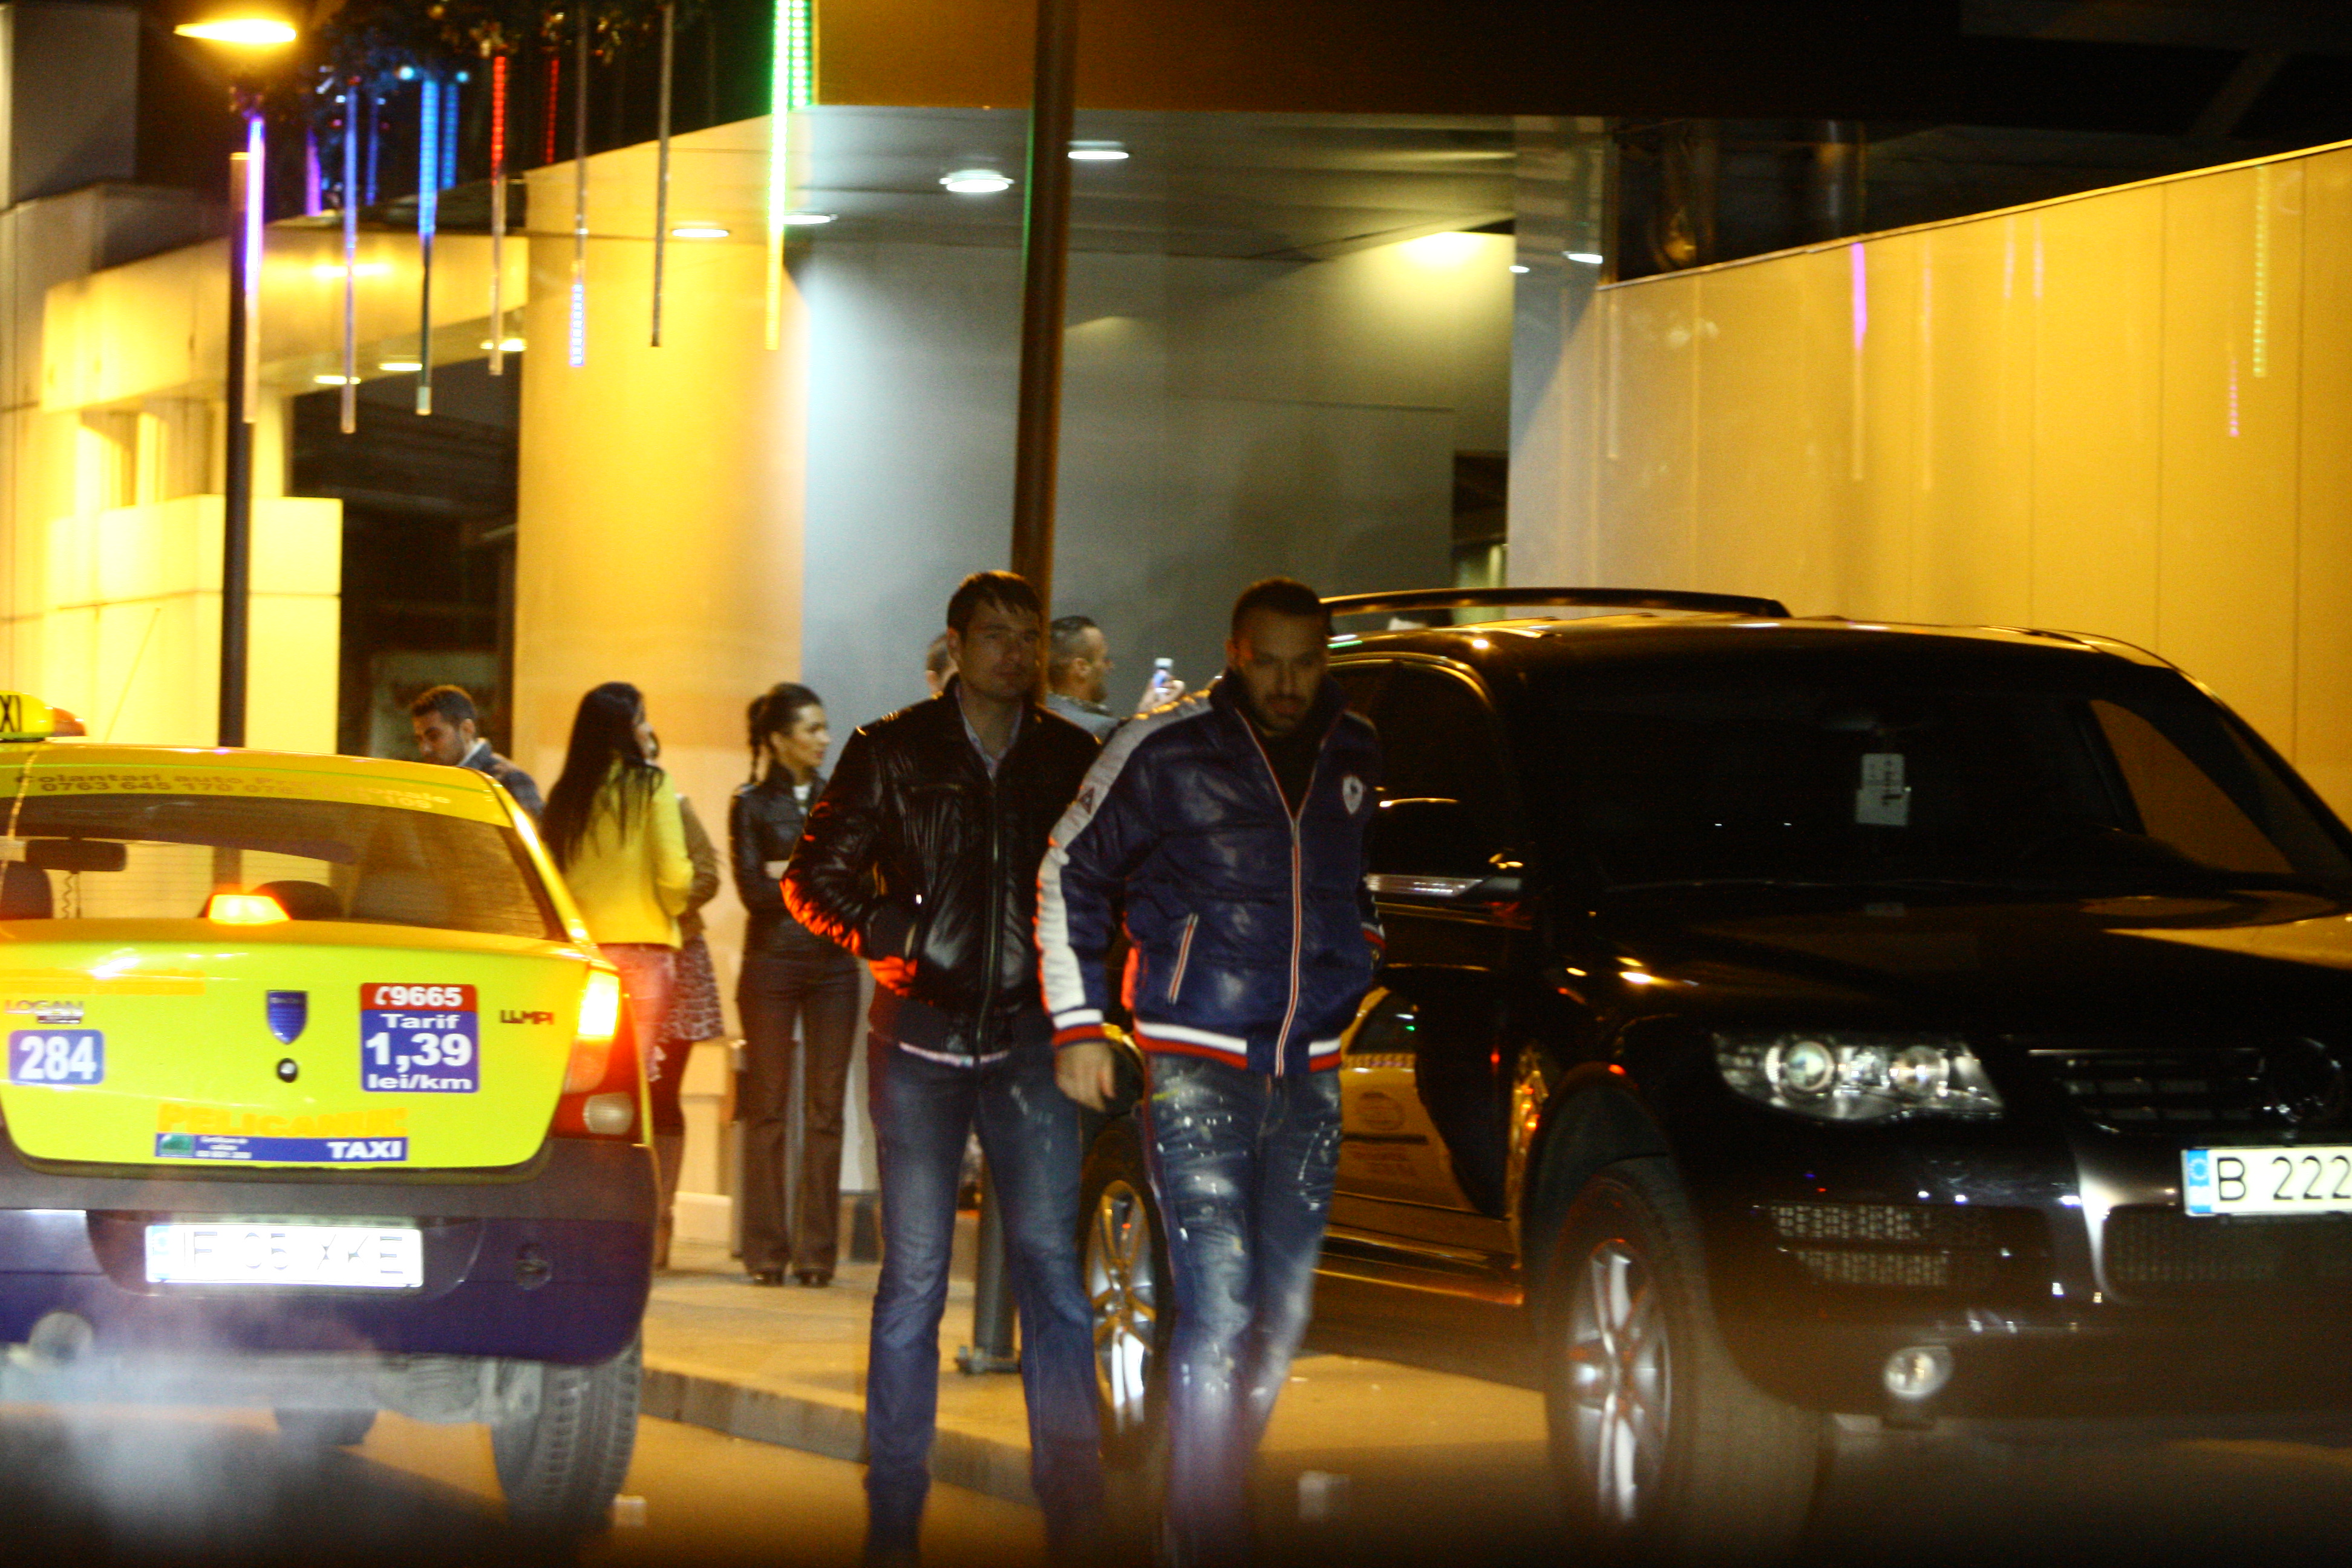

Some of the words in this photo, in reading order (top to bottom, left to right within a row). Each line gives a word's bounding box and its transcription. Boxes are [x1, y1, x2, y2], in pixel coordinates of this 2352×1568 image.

[390, 985, 463, 1007] 9665
[380, 1013, 462, 1029] Tarif
[18, 1035, 97, 1080] 284
[365, 1032, 473, 1073] 1,39
[368, 1074, 472, 1089] lei/km
[327, 1140, 402, 1160] TAXI
[2218, 1156, 2247, 1202] B
